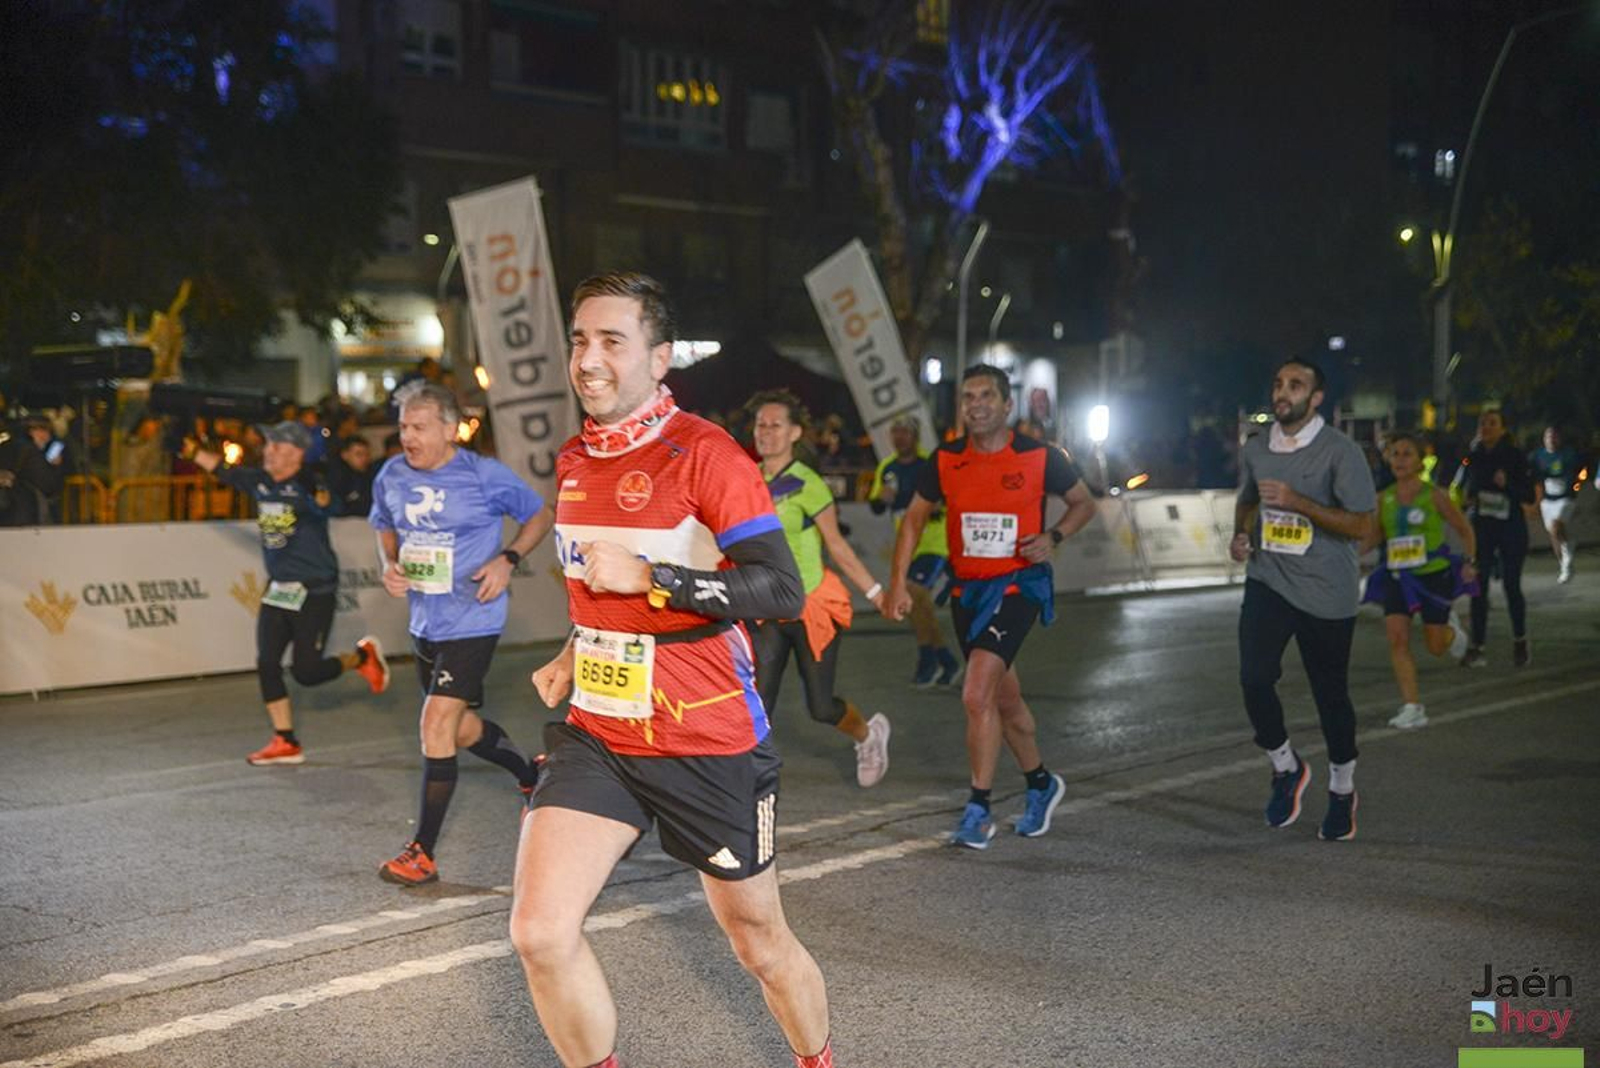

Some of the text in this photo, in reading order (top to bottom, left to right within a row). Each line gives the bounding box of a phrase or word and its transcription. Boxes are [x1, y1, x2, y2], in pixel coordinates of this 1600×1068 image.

[971, 530, 1005, 542] 5471
[82, 578, 209, 606] CAJA RURAL
[581, 660, 629, 688] 6695
